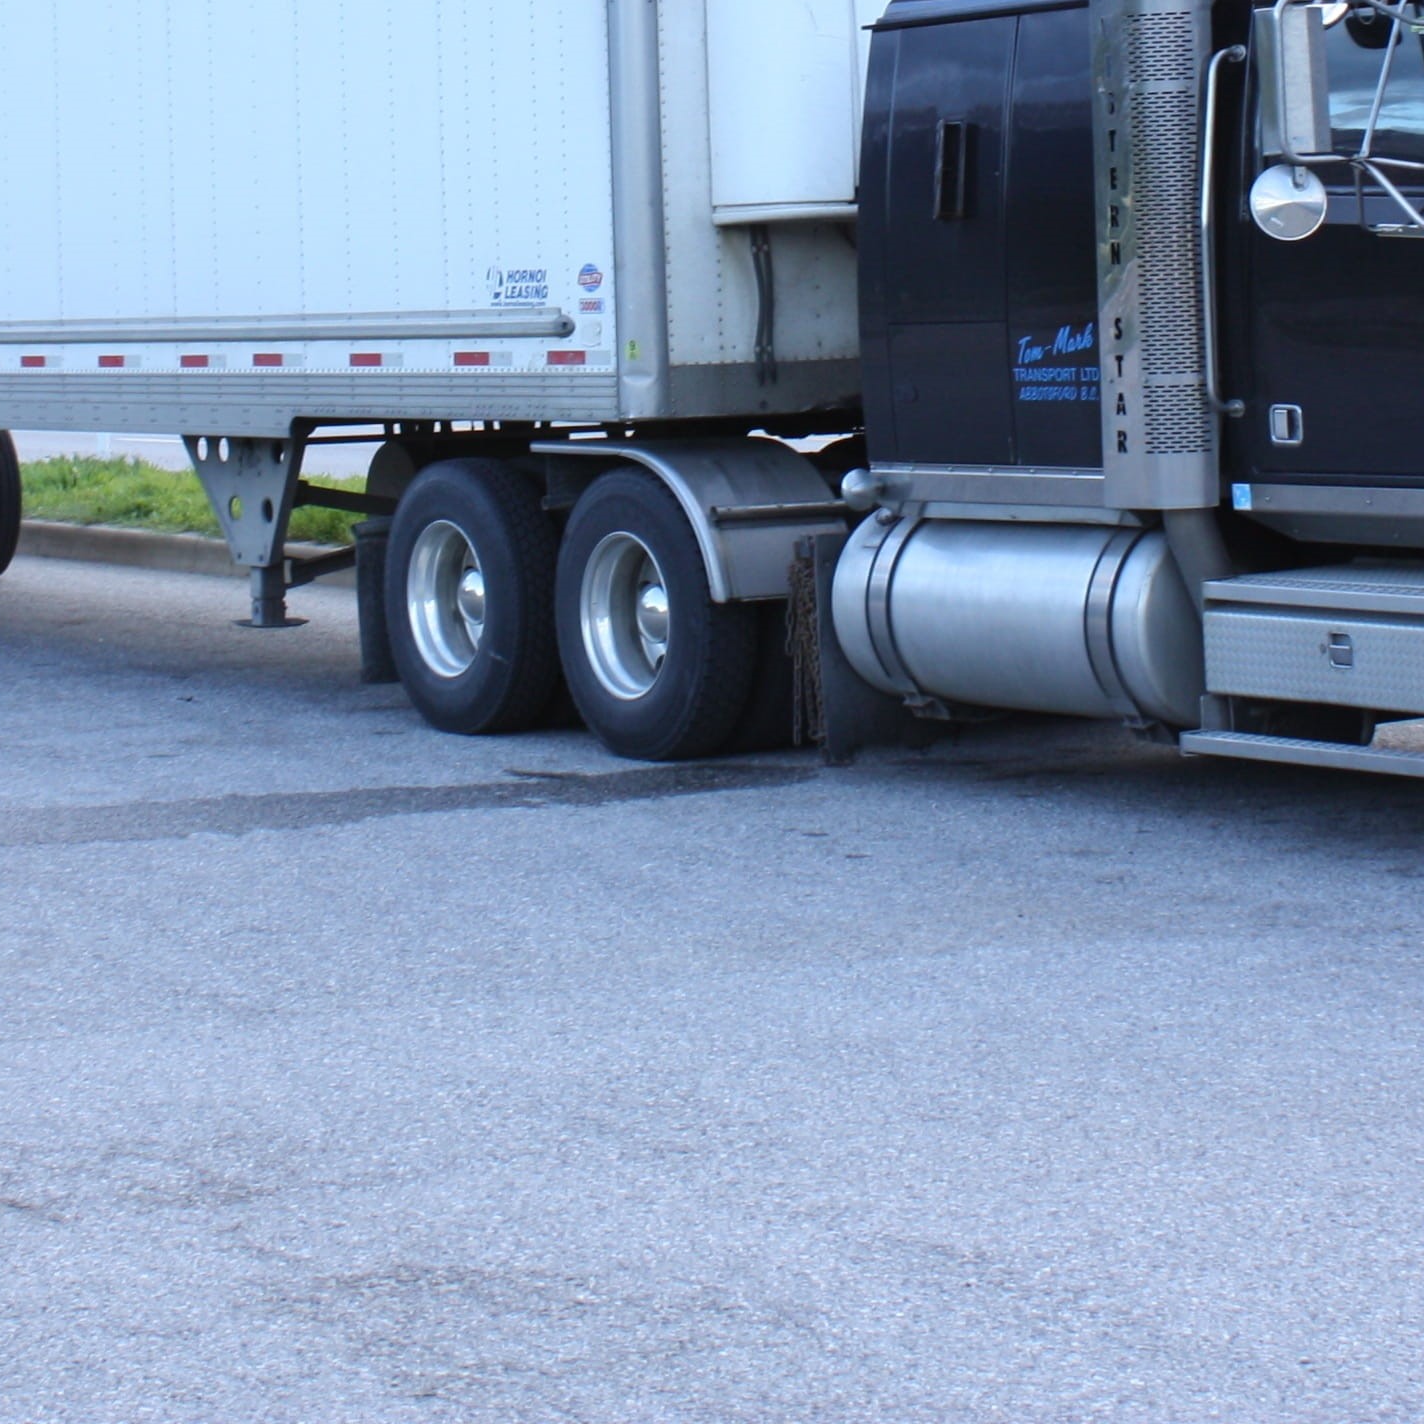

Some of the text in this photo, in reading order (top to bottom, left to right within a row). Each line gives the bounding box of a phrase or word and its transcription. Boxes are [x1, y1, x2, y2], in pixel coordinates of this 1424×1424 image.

[507, 269, 547, 284] HORNOI
[505, 285, 549, 300] LEASING
[1018, 322, 1093, 364] Tom-Mark
[1013, 367, 1100, 382] TRANSPORT LTD
[1114, 317, 1128, 454] STAR
